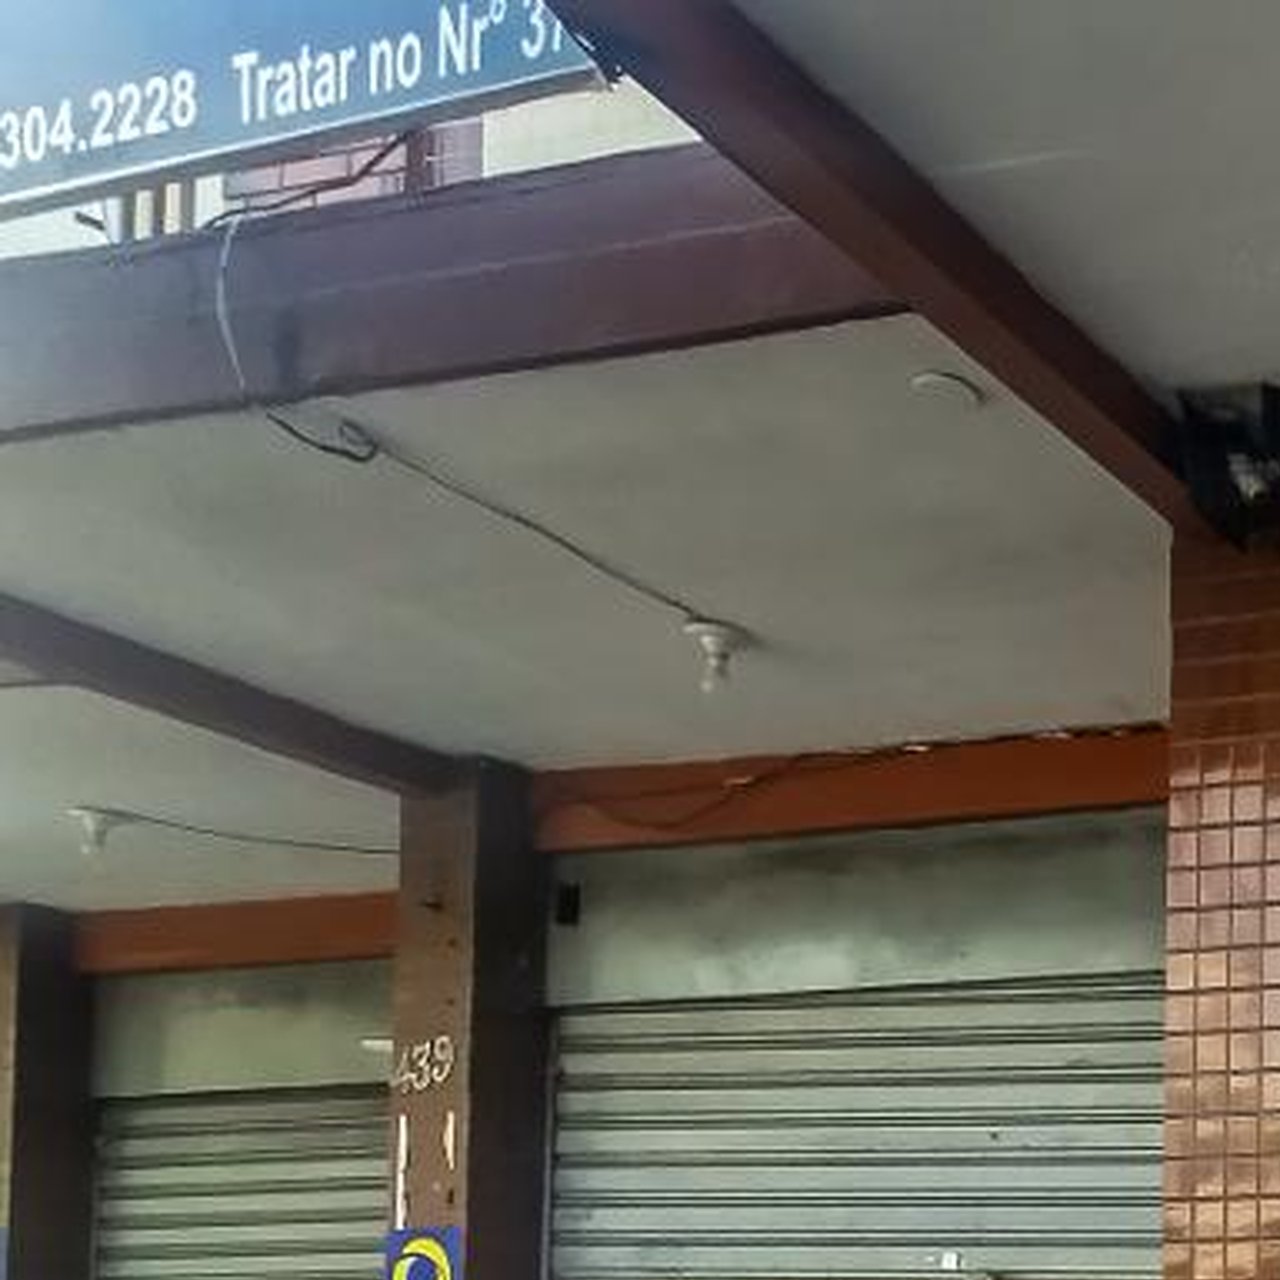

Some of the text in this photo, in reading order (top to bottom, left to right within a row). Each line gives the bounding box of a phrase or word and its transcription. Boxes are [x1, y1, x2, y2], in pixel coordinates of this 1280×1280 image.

[0, 69, 197, 169] 304.2228
[231, 43, 356, 125] Tratar
[369, 32, 421, 96] no
